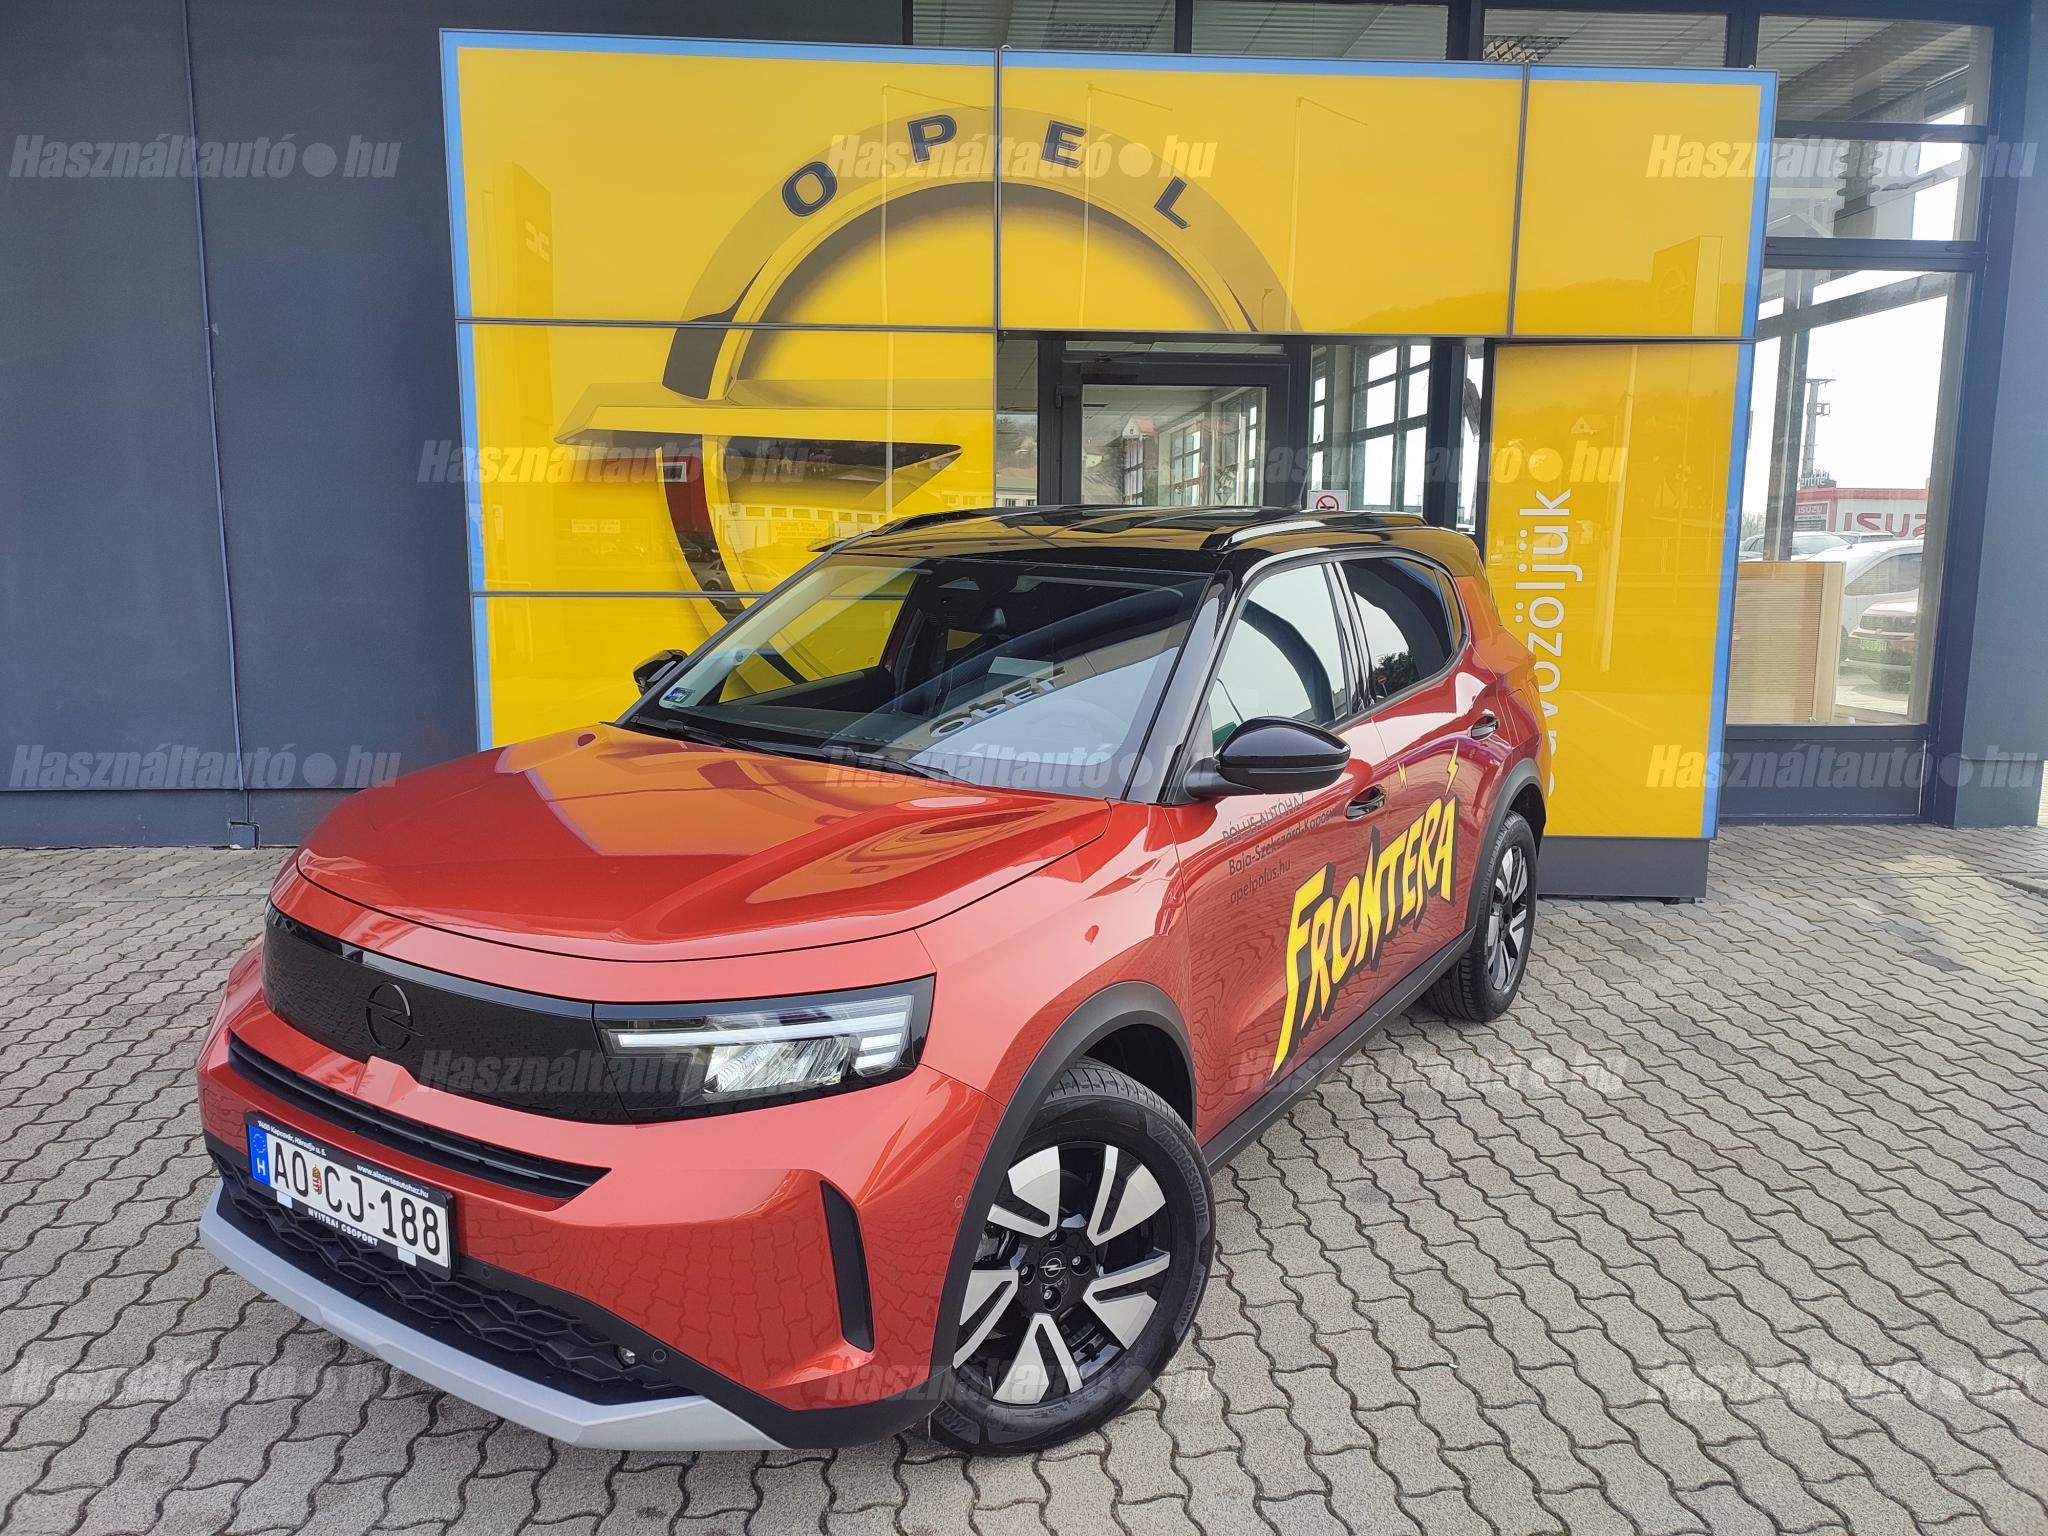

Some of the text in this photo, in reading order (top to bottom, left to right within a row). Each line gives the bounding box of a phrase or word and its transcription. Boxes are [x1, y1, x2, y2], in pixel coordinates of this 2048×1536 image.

[781, 114, 1191, 230] OPEL
[1267, 795, 1461, 1082] FRONTERA
[256, 1157, 266, 1177] H
[274, 1141, 310, 1198] AO
[341, 1223, 378, 1246] CSOPORT
